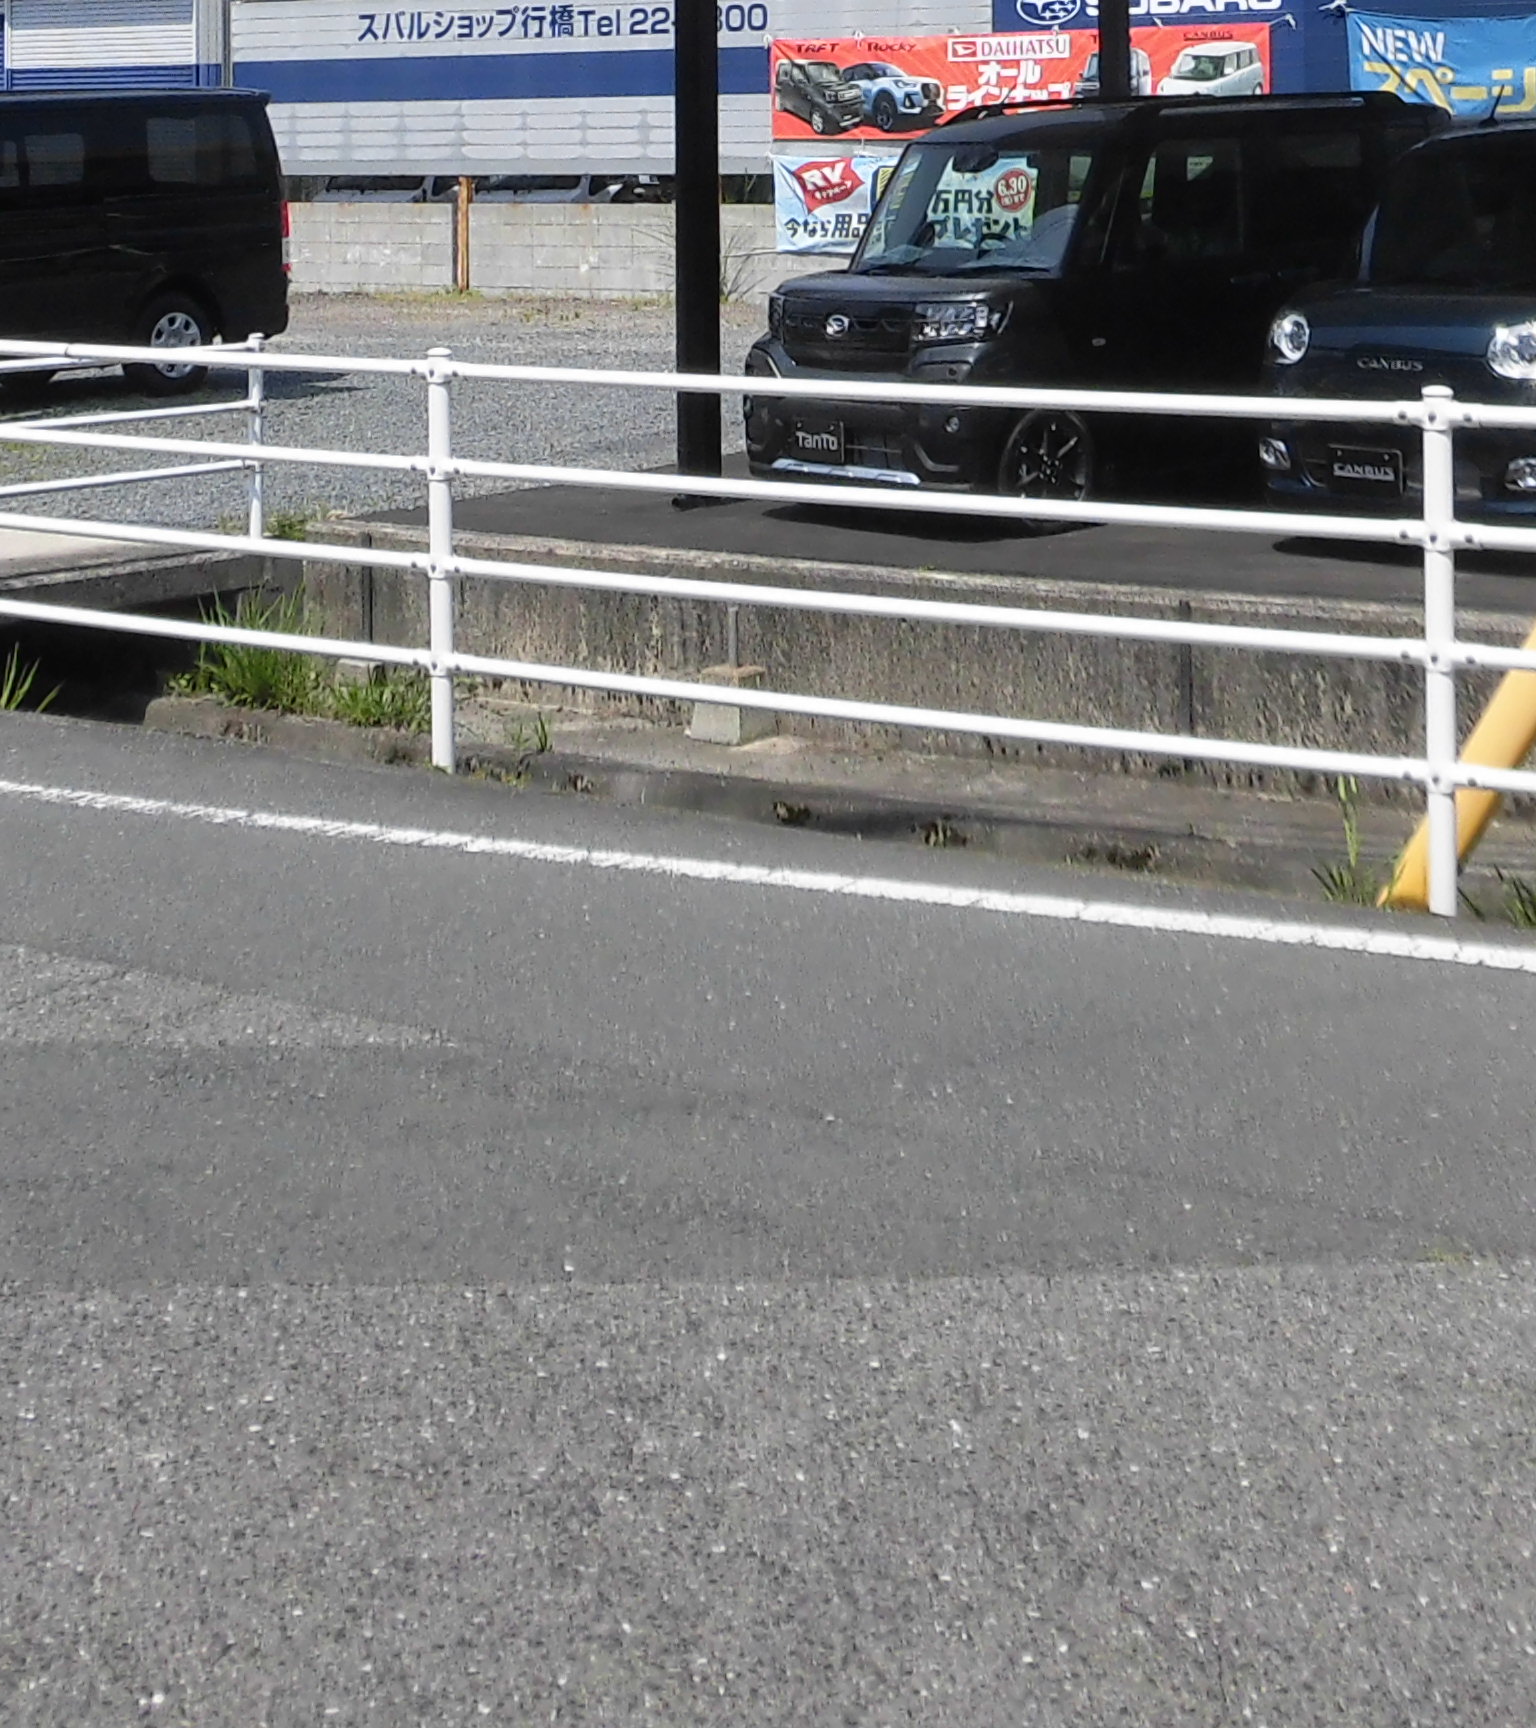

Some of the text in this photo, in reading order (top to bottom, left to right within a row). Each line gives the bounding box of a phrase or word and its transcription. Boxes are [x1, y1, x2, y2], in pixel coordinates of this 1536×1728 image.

[981, 37, 1067, 56] DAIHATSU
[1361, 25, 1445, 62] NEW
[978, 60, 1041, 84] オール
[947, 82, 1071, 111] ラインナップ
[800, 162, 847, 190] RV
[932, 188, 994, 215] 万円分
[1333, 463, 1395, 480] CANBUS
